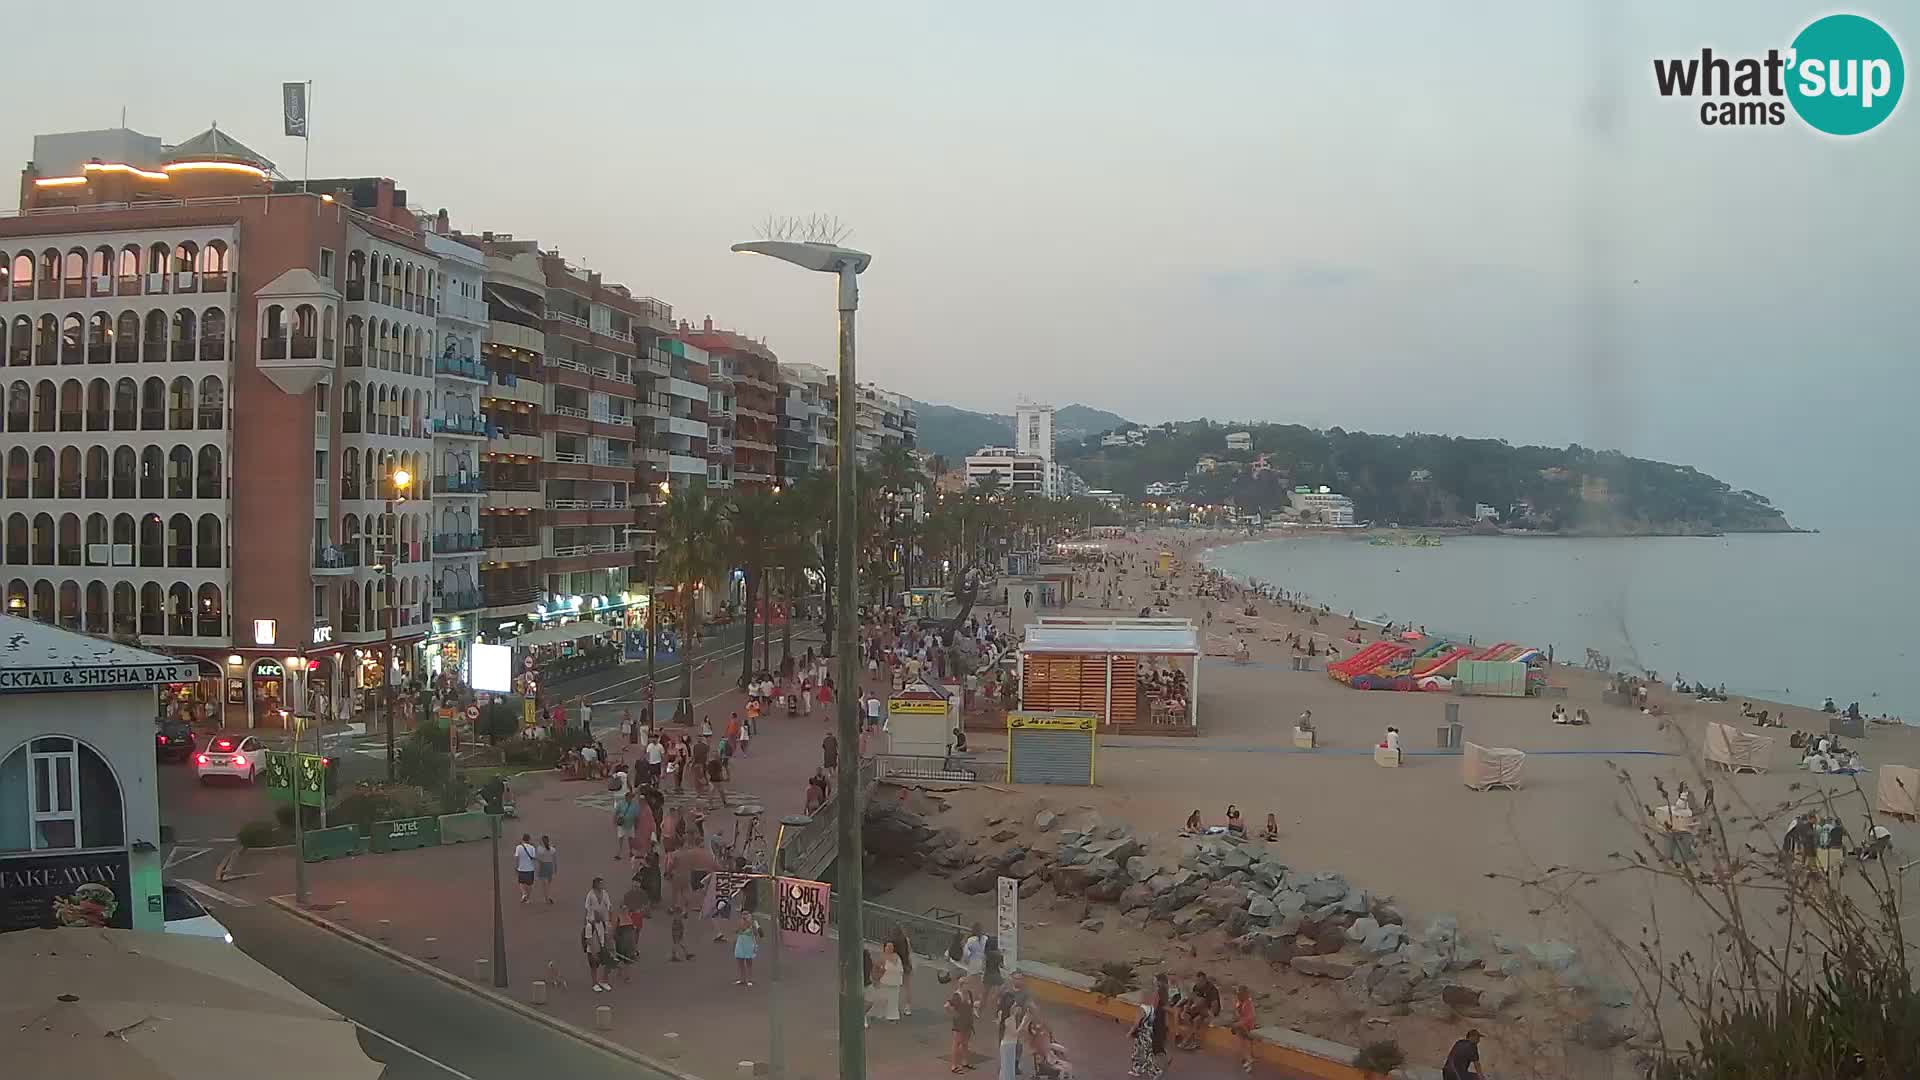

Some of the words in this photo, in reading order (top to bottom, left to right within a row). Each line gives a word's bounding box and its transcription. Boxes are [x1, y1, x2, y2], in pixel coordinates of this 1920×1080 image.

[312, 626, 332, 643] KFC
[63, 670, 74, 684] &
[80, 668, 139, 684] SHISHA
[145, 667, 177, 681] BAR
[258, 665, 281, 676] KFC
